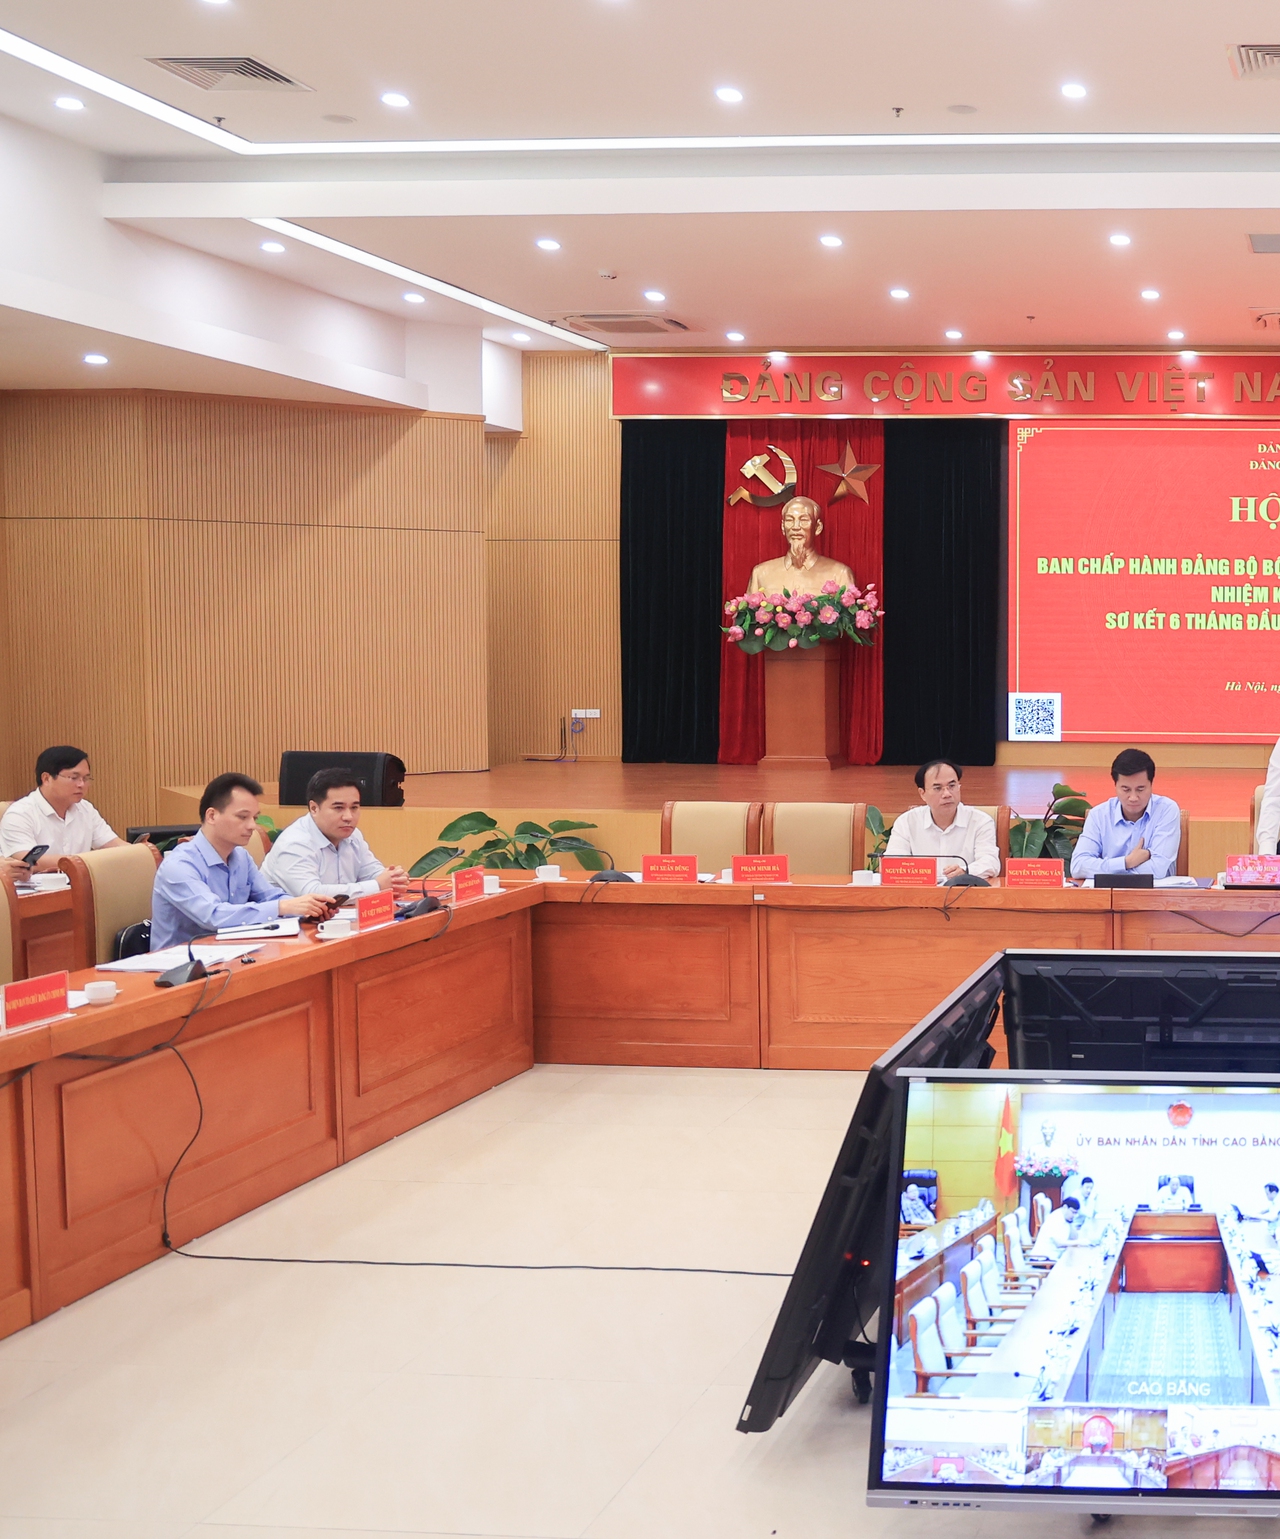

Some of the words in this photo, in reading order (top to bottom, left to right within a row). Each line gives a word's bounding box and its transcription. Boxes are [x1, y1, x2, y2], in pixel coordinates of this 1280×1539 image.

[720, 358, 843, 402] ĐẢNG
[863, 361, 987, 410] CỘNG
[1007, 358, 1094, 402] SẢN
[1115, 363, 1214, 411] VIỆT
[1037, 557, 1074, 574] BAN
[1078, 552, 1125, 575] CHẤP
[1129, 555, 1177, 575] HÀNH
[1181, 553, 1229, 576] ĐẢNG
[1234, 555, 1258, 579] BỘ
[1211, 583, 1269, 606] NHIỆM
[1105, 610, 1130, 629] SƠ
[1133, 607, 1167, 629] KẾT
[1169, 612, 1181, 629] 6
[1185, 610, 1243, 630] THÁNG
[1225, 682, 1241, 692] Hà
[1245, 681, 1267, 693] Nội,
[1097, 1137, 1121, 1147] BAN
[1222, 1137, 1247, 1147] CAO
[1127, 1381, 1163, 1396] CAO
